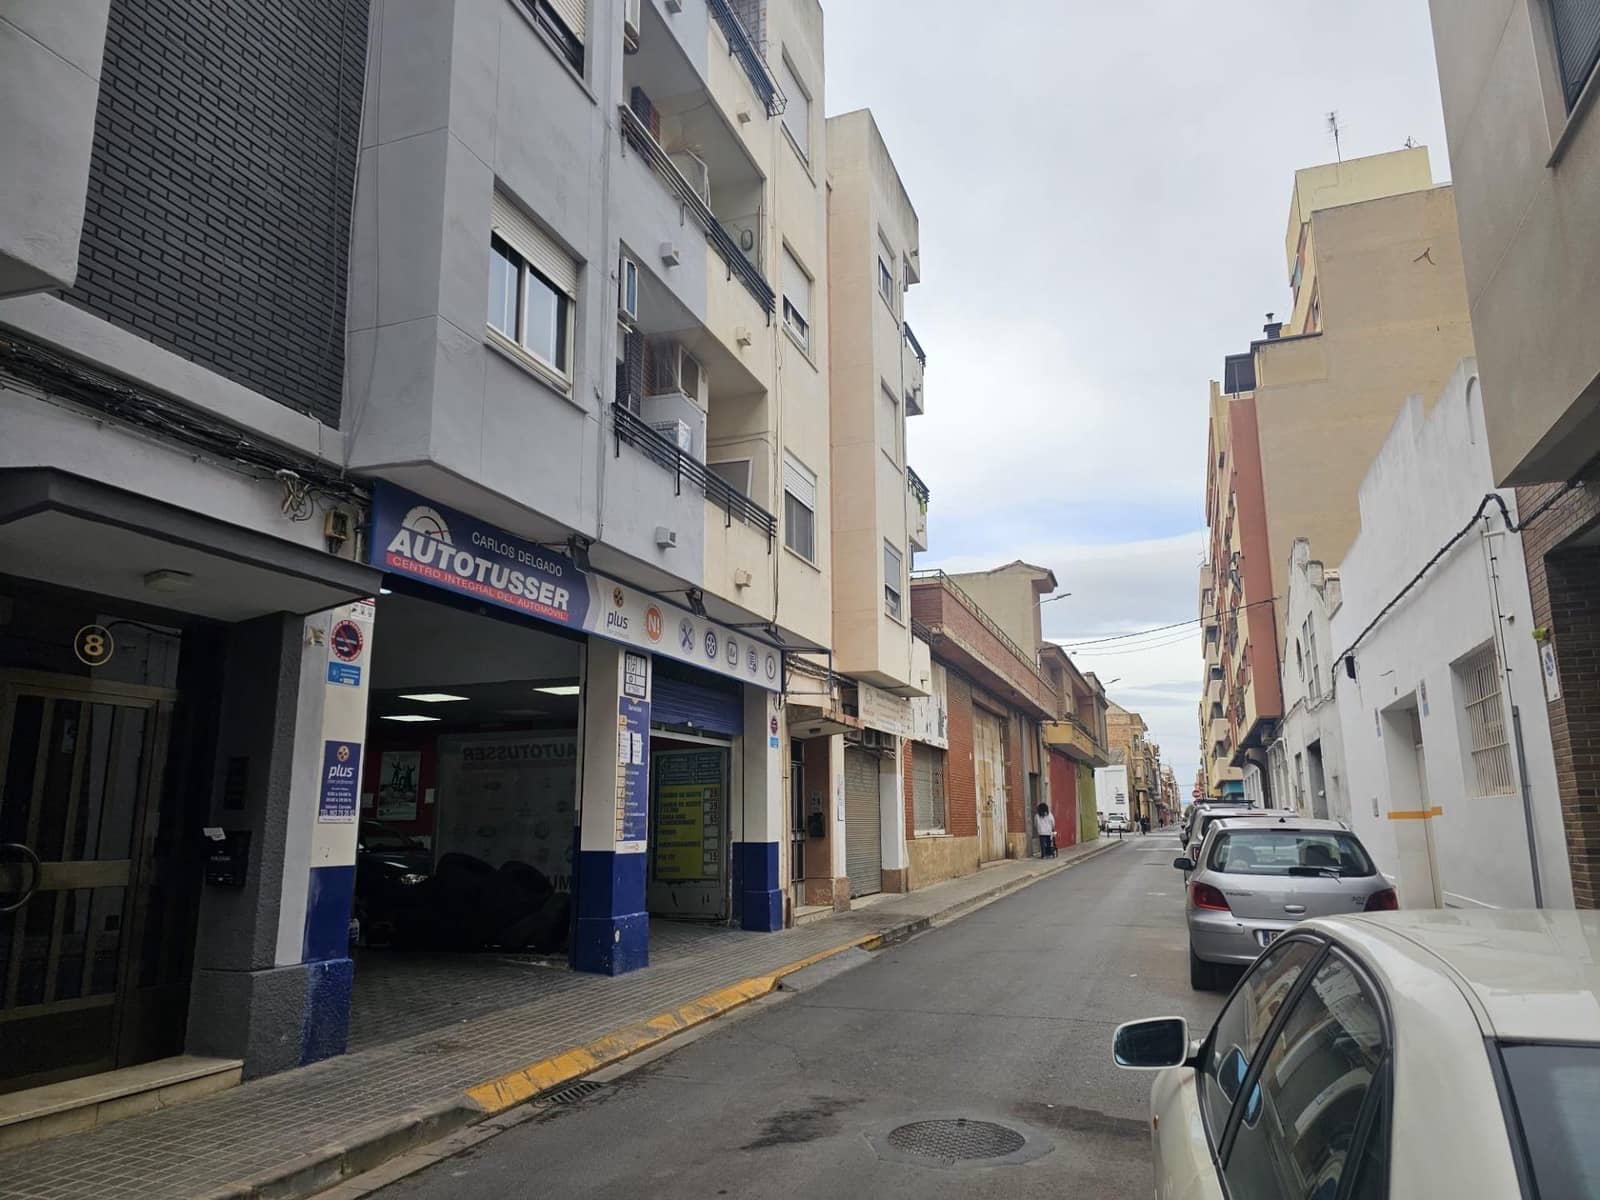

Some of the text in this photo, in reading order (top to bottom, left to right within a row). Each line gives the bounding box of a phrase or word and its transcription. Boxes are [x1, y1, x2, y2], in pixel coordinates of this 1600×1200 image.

[387, 529, 570, 611] AUTOTUSSER
[472, 532, 562, 577] CARLOS DELGADO
[392, 557, 440, 578] CENTRO
[445, 571, 495, 597] INTEGRAL
[497, 592, 514, 604] DEL
[607, 611, 629, 630] plus
[85, 635, 104, 655] 8
[328, 764, 353, 779] plus
